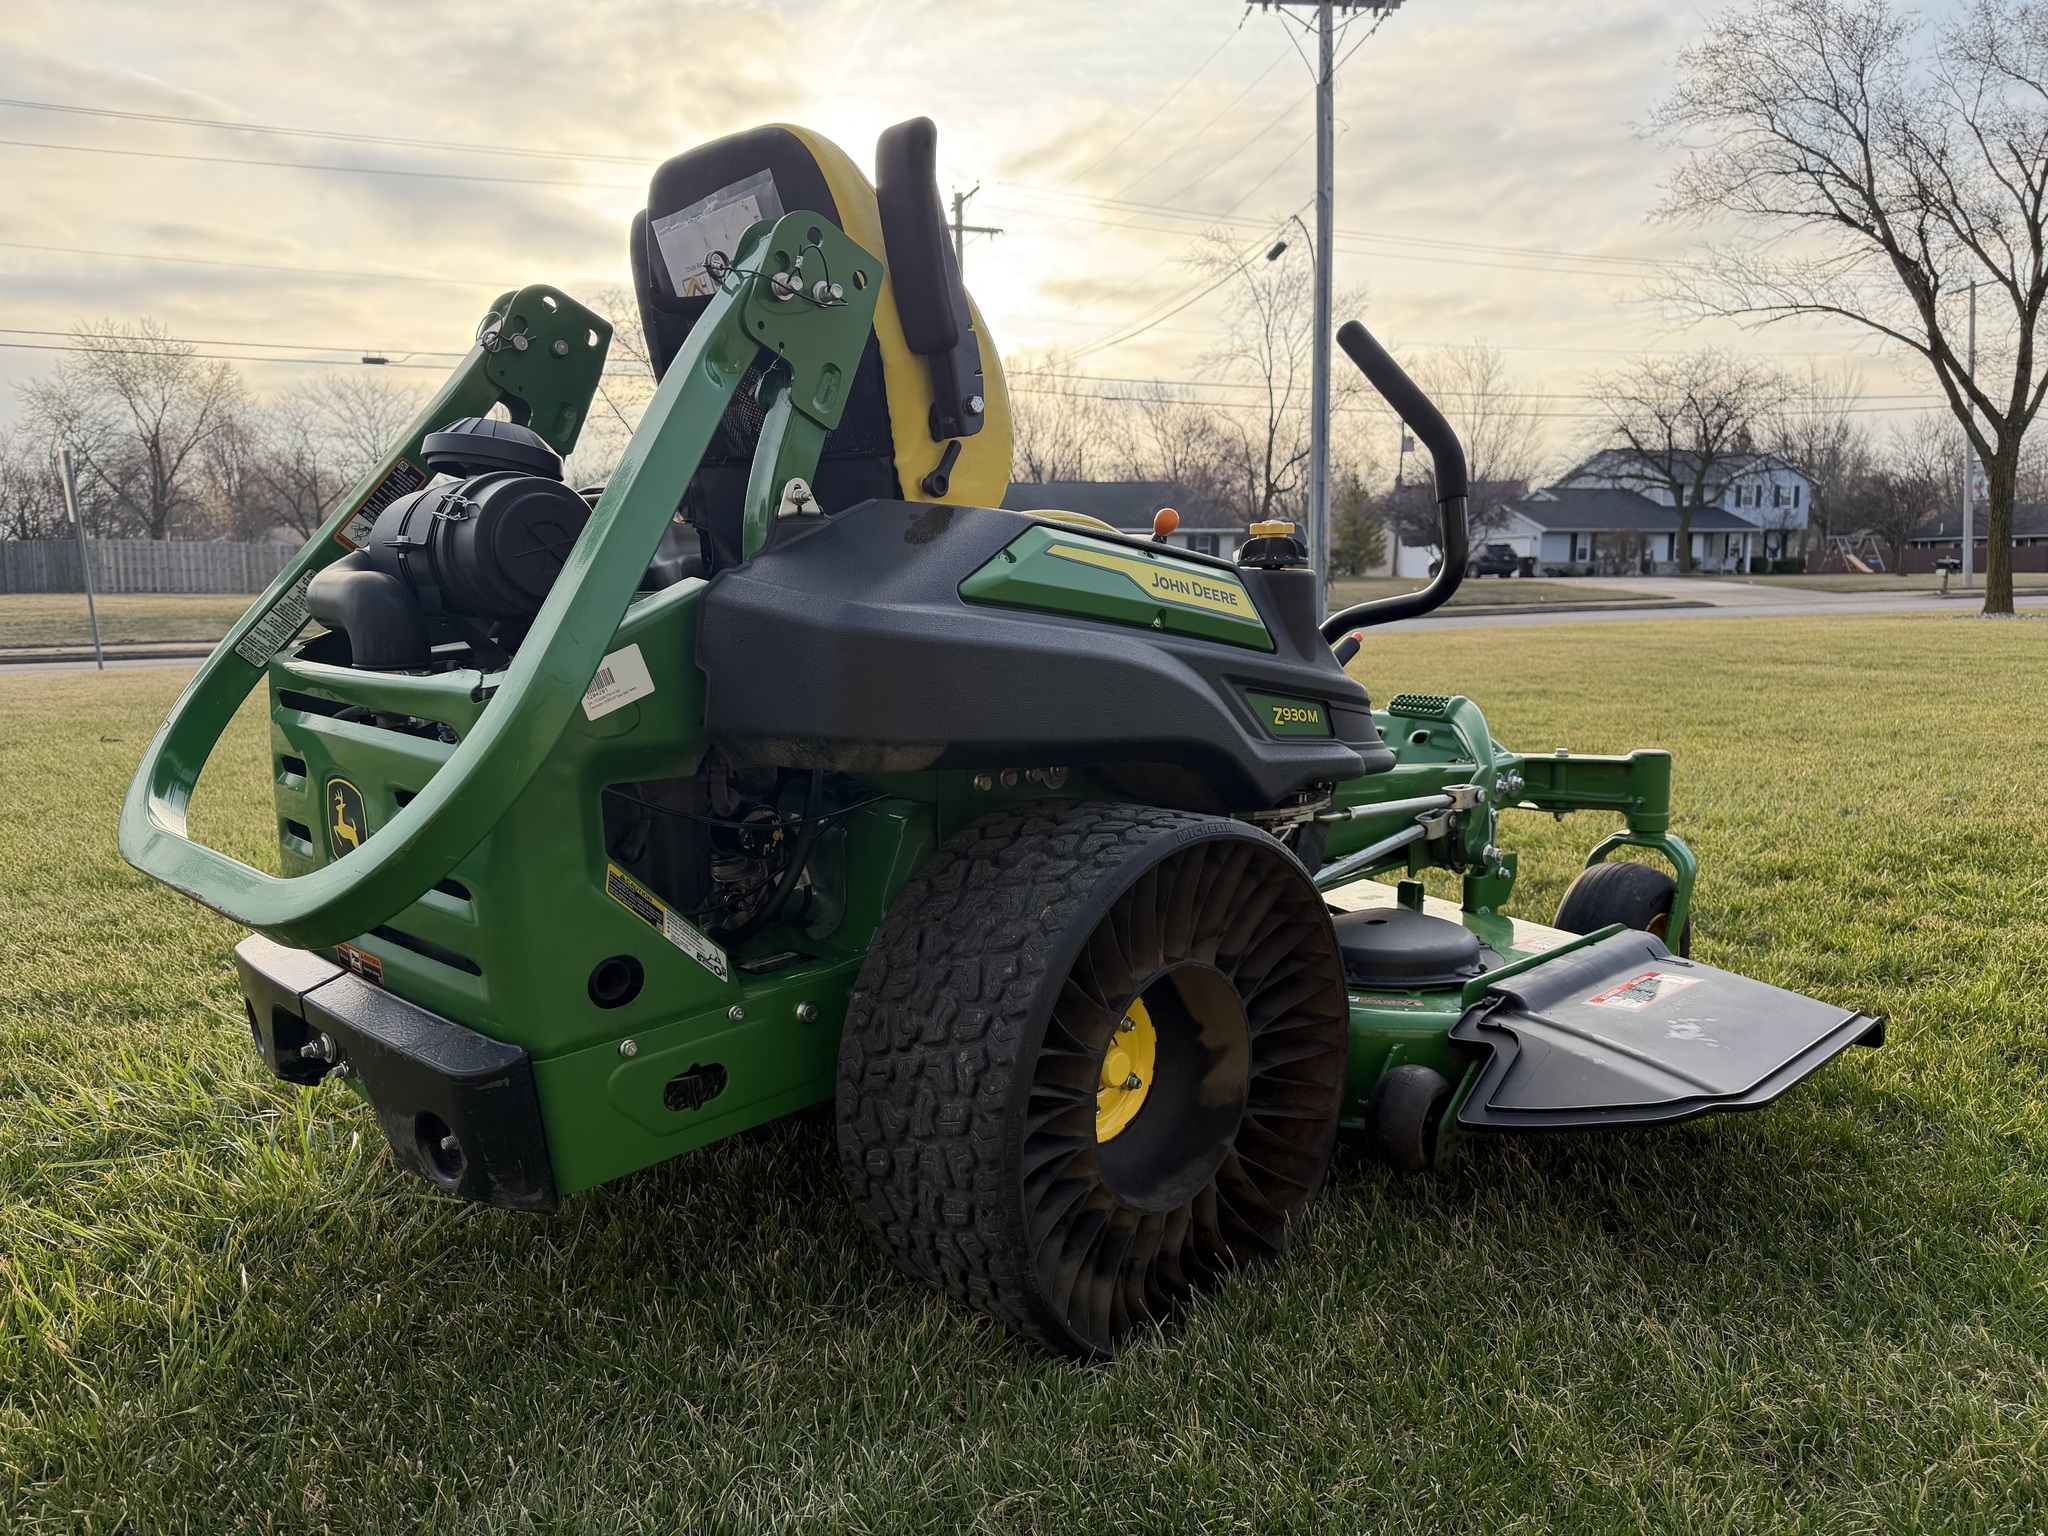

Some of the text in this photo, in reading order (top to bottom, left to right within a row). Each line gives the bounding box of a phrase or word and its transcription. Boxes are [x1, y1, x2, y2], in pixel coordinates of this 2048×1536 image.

[1152, 572, 1238, 606] JOHN DEERE
[1272, 706, 1319, 725] Z930M
[1177, 824, 1234, 841] MICHELIN
[625, 878, 653, 902] CAUTION
